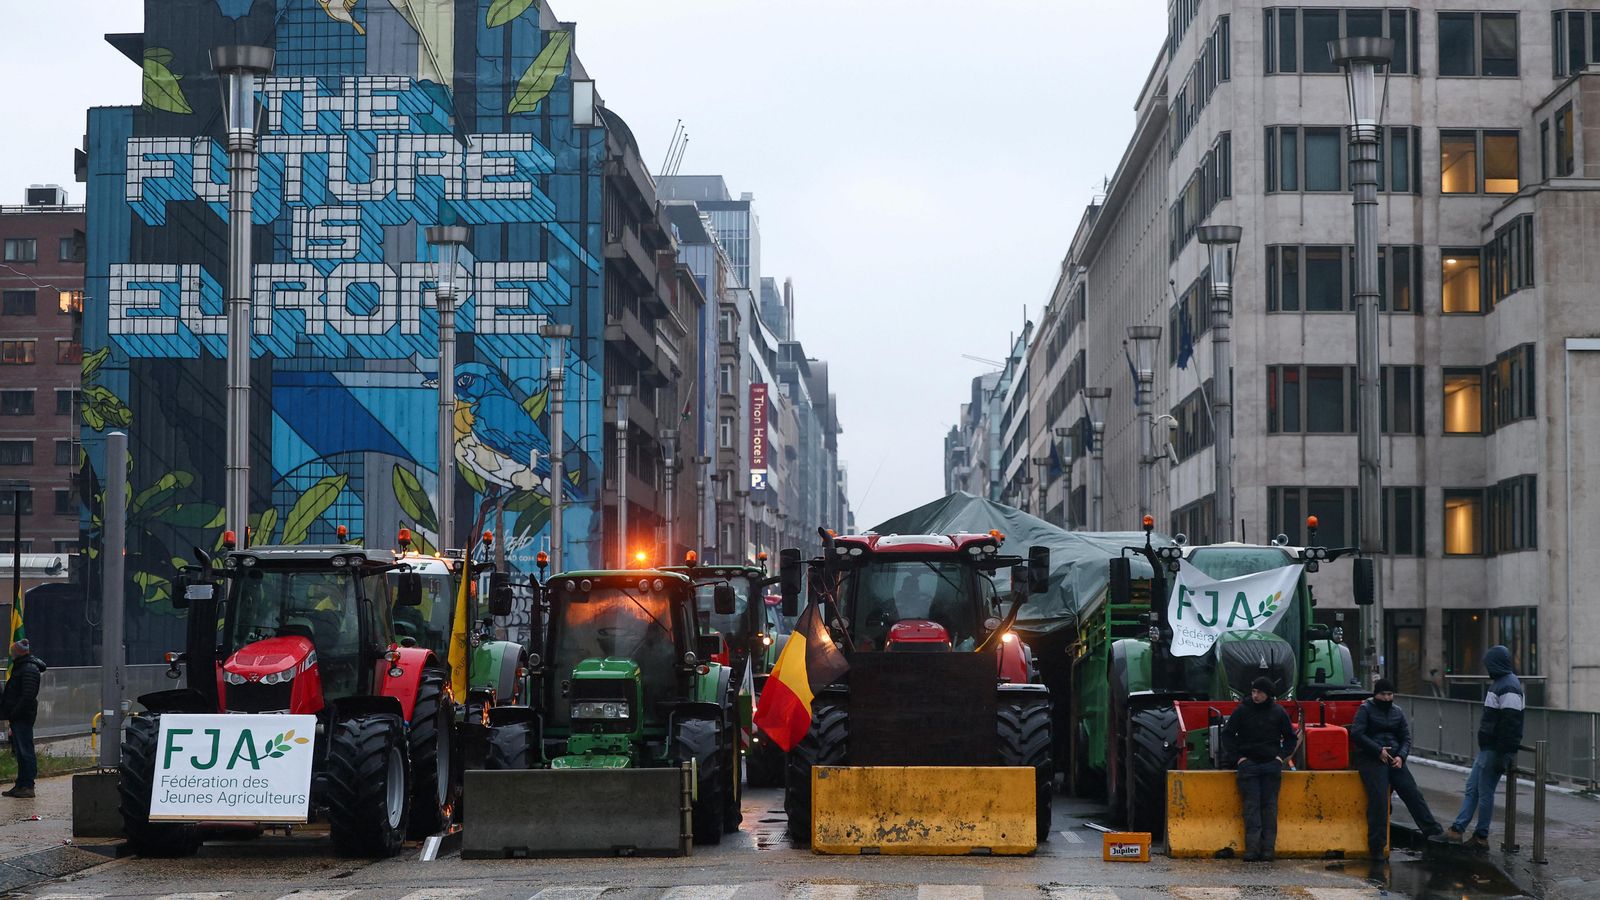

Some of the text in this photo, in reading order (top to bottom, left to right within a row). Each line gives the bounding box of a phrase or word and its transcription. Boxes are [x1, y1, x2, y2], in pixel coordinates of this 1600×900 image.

[254, 75, 410, 131] THE
[126, 133, 533, 202] FUTURE
[291, 205, 362, 259] IS
[108, 262, 548, 335] EUROPE
[753, 395, 765, 464] Thon Hotels
[1176, 584, 1256, 628] FJA
[1176, 624, 1218, 643] Fédéra
[1178, 637, 1209, 649] Jeun
[163, 728, 260, 770] FJA
[160, 790, 306, 807] Jeunes Agriculteurs
[161, 775, 269, 788] Fédération des
[1112, 847, 1139, 855] Jupiler
